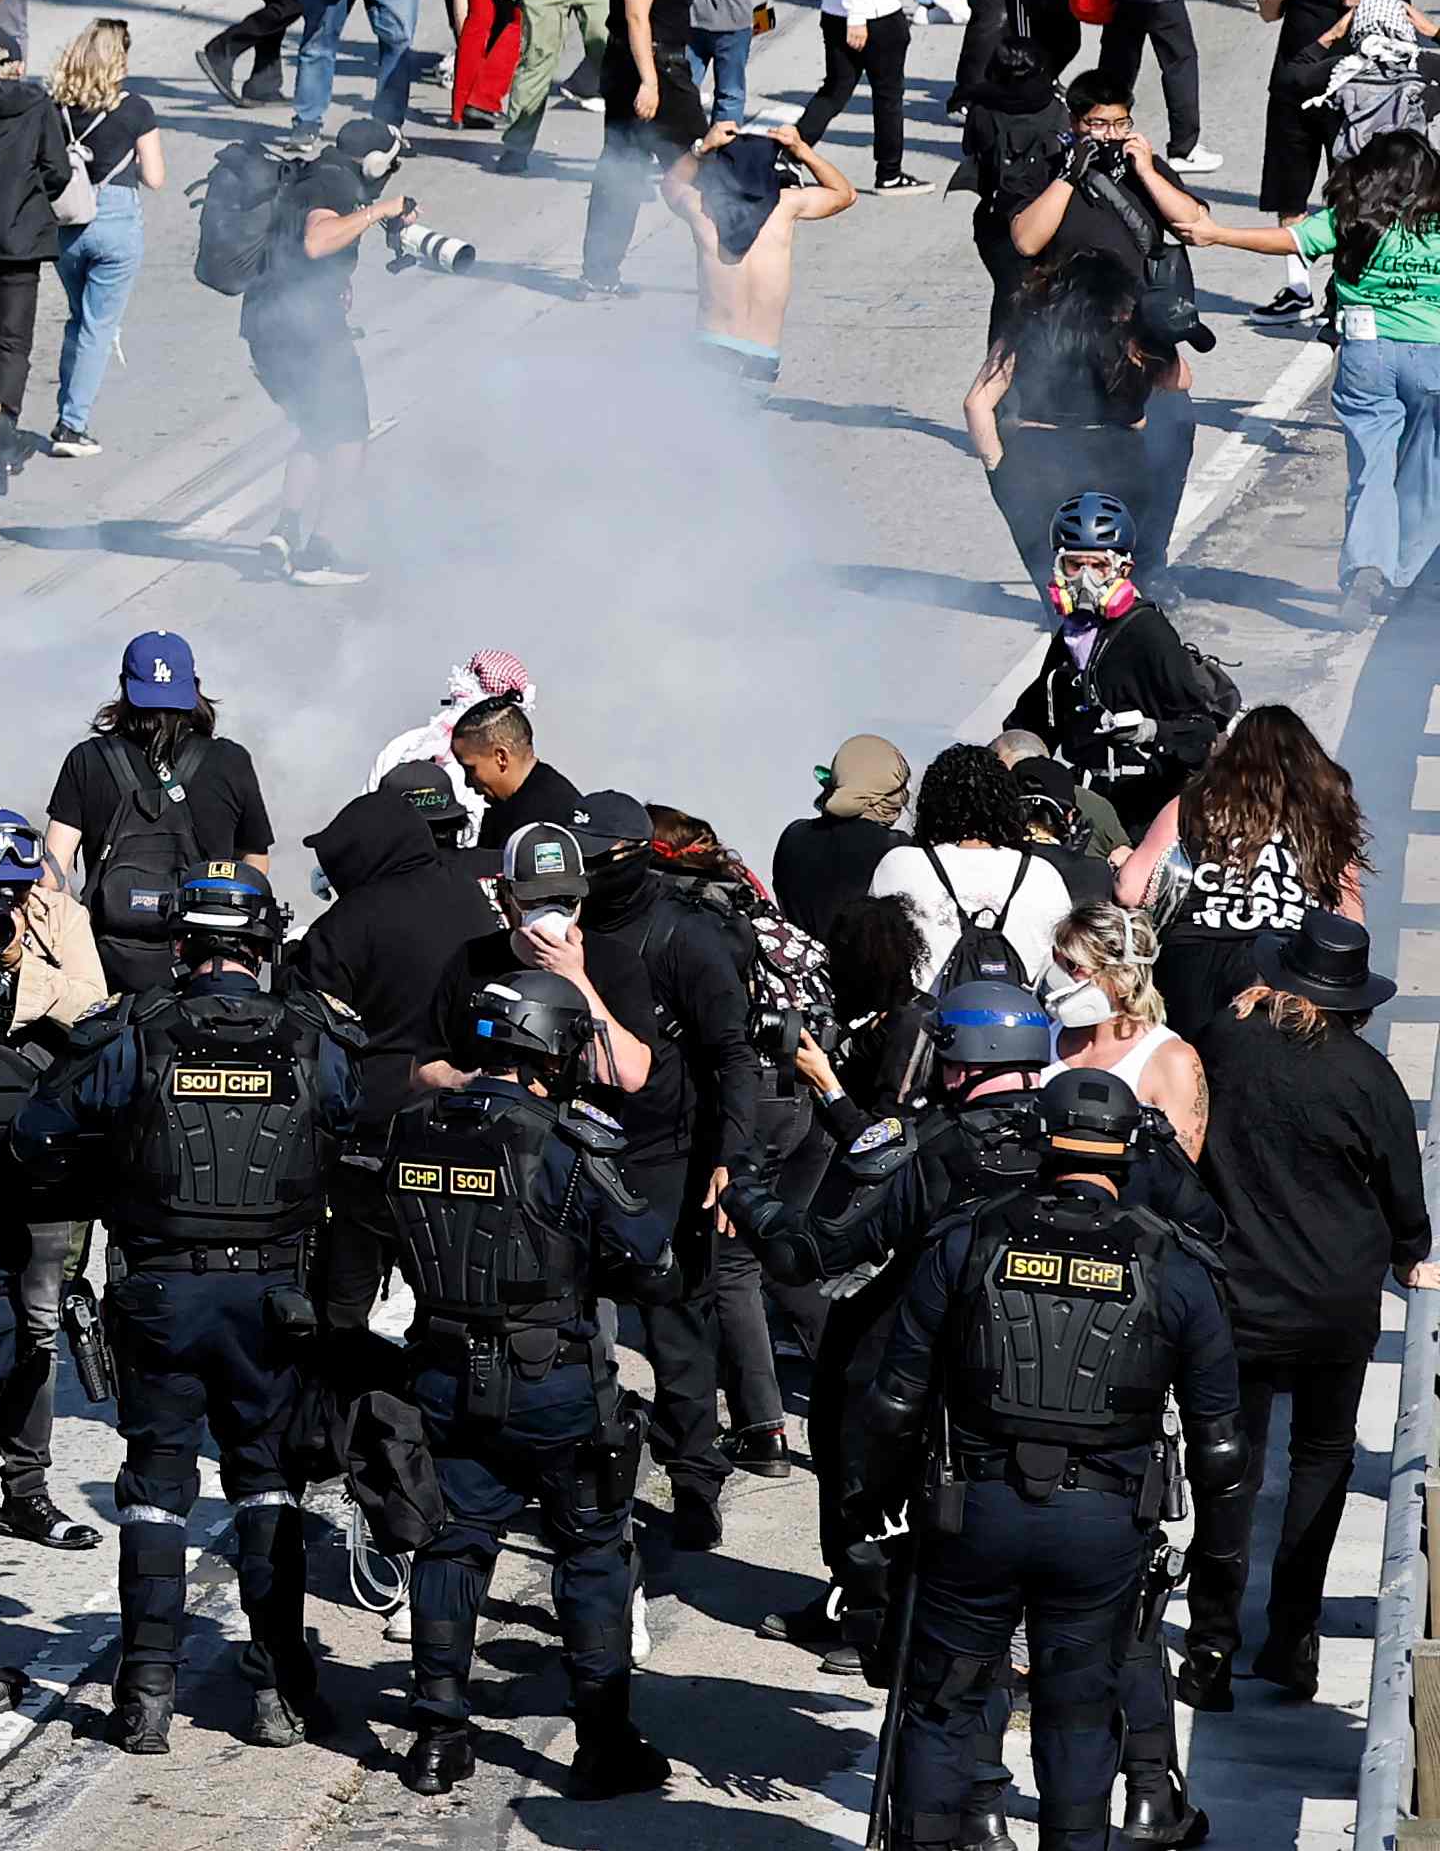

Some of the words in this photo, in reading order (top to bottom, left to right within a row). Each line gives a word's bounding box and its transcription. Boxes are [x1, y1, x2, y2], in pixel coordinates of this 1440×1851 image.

[180, 1075, 218, 1092] SOU
[228, 1074, 267, 1092] CHP
[404, 1168, 438, 1186] CHP
[456, 1173, 489, 1190] SOU
[1014, 1258, 1056, 1278] SOU
[1076, 1265, 1115, 1285] CHP
